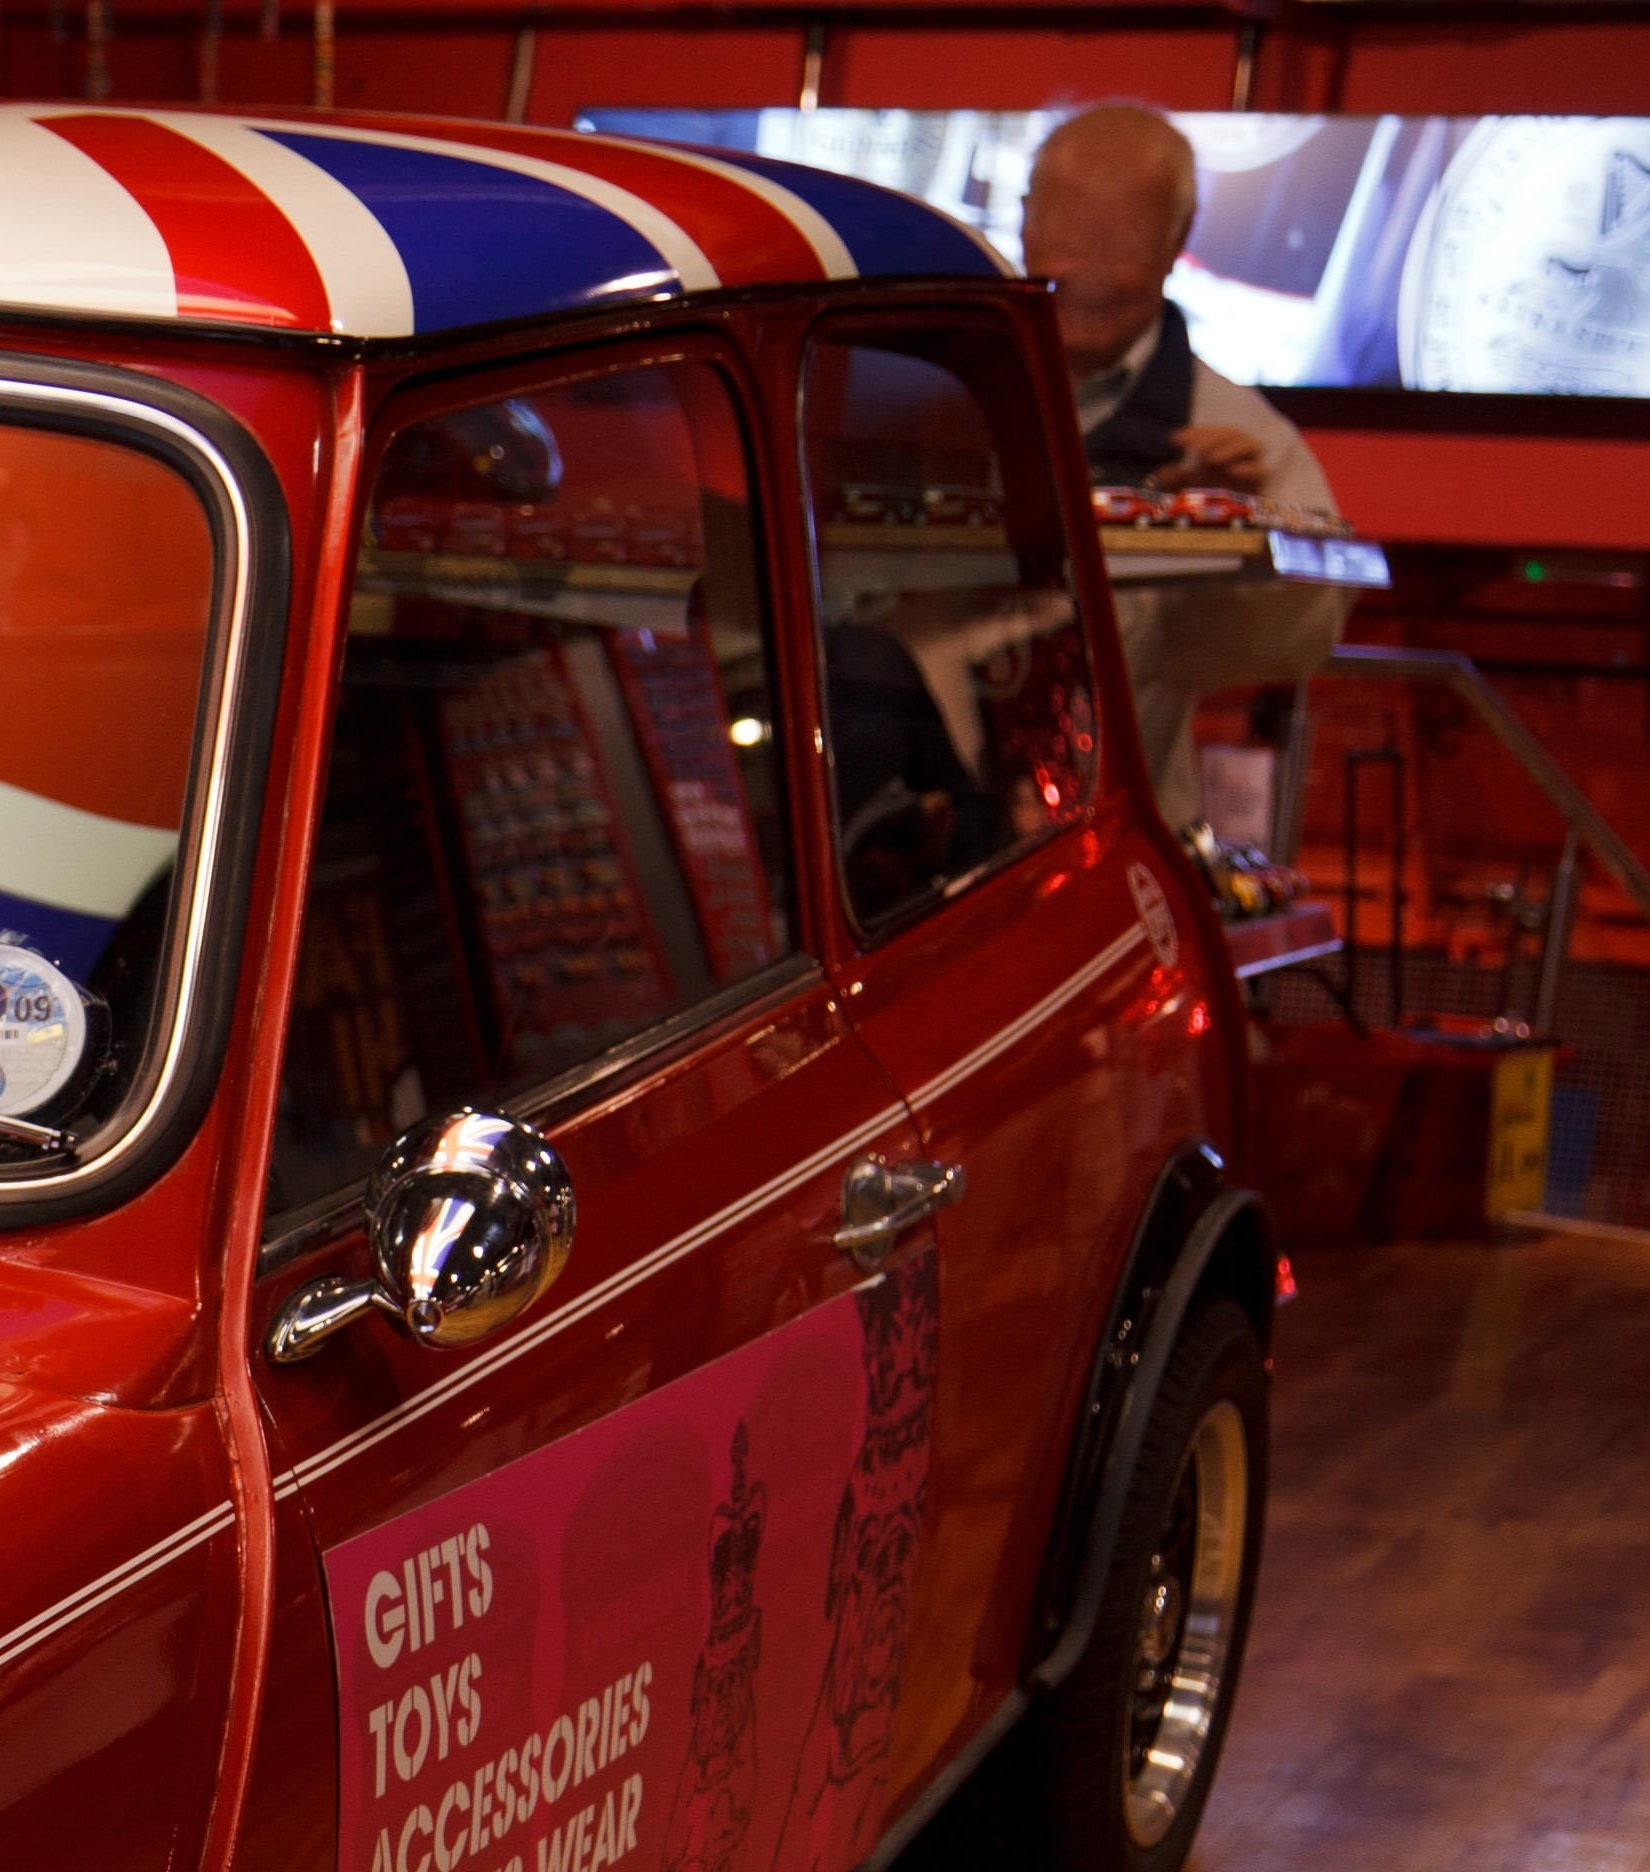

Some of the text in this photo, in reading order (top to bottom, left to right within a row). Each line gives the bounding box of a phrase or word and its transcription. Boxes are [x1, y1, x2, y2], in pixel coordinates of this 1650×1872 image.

[15, 996, 52, 1022] 09
[365, 1522, 494, 1669] GIFTS
[369, 1652, 482, 1799] TOYS
